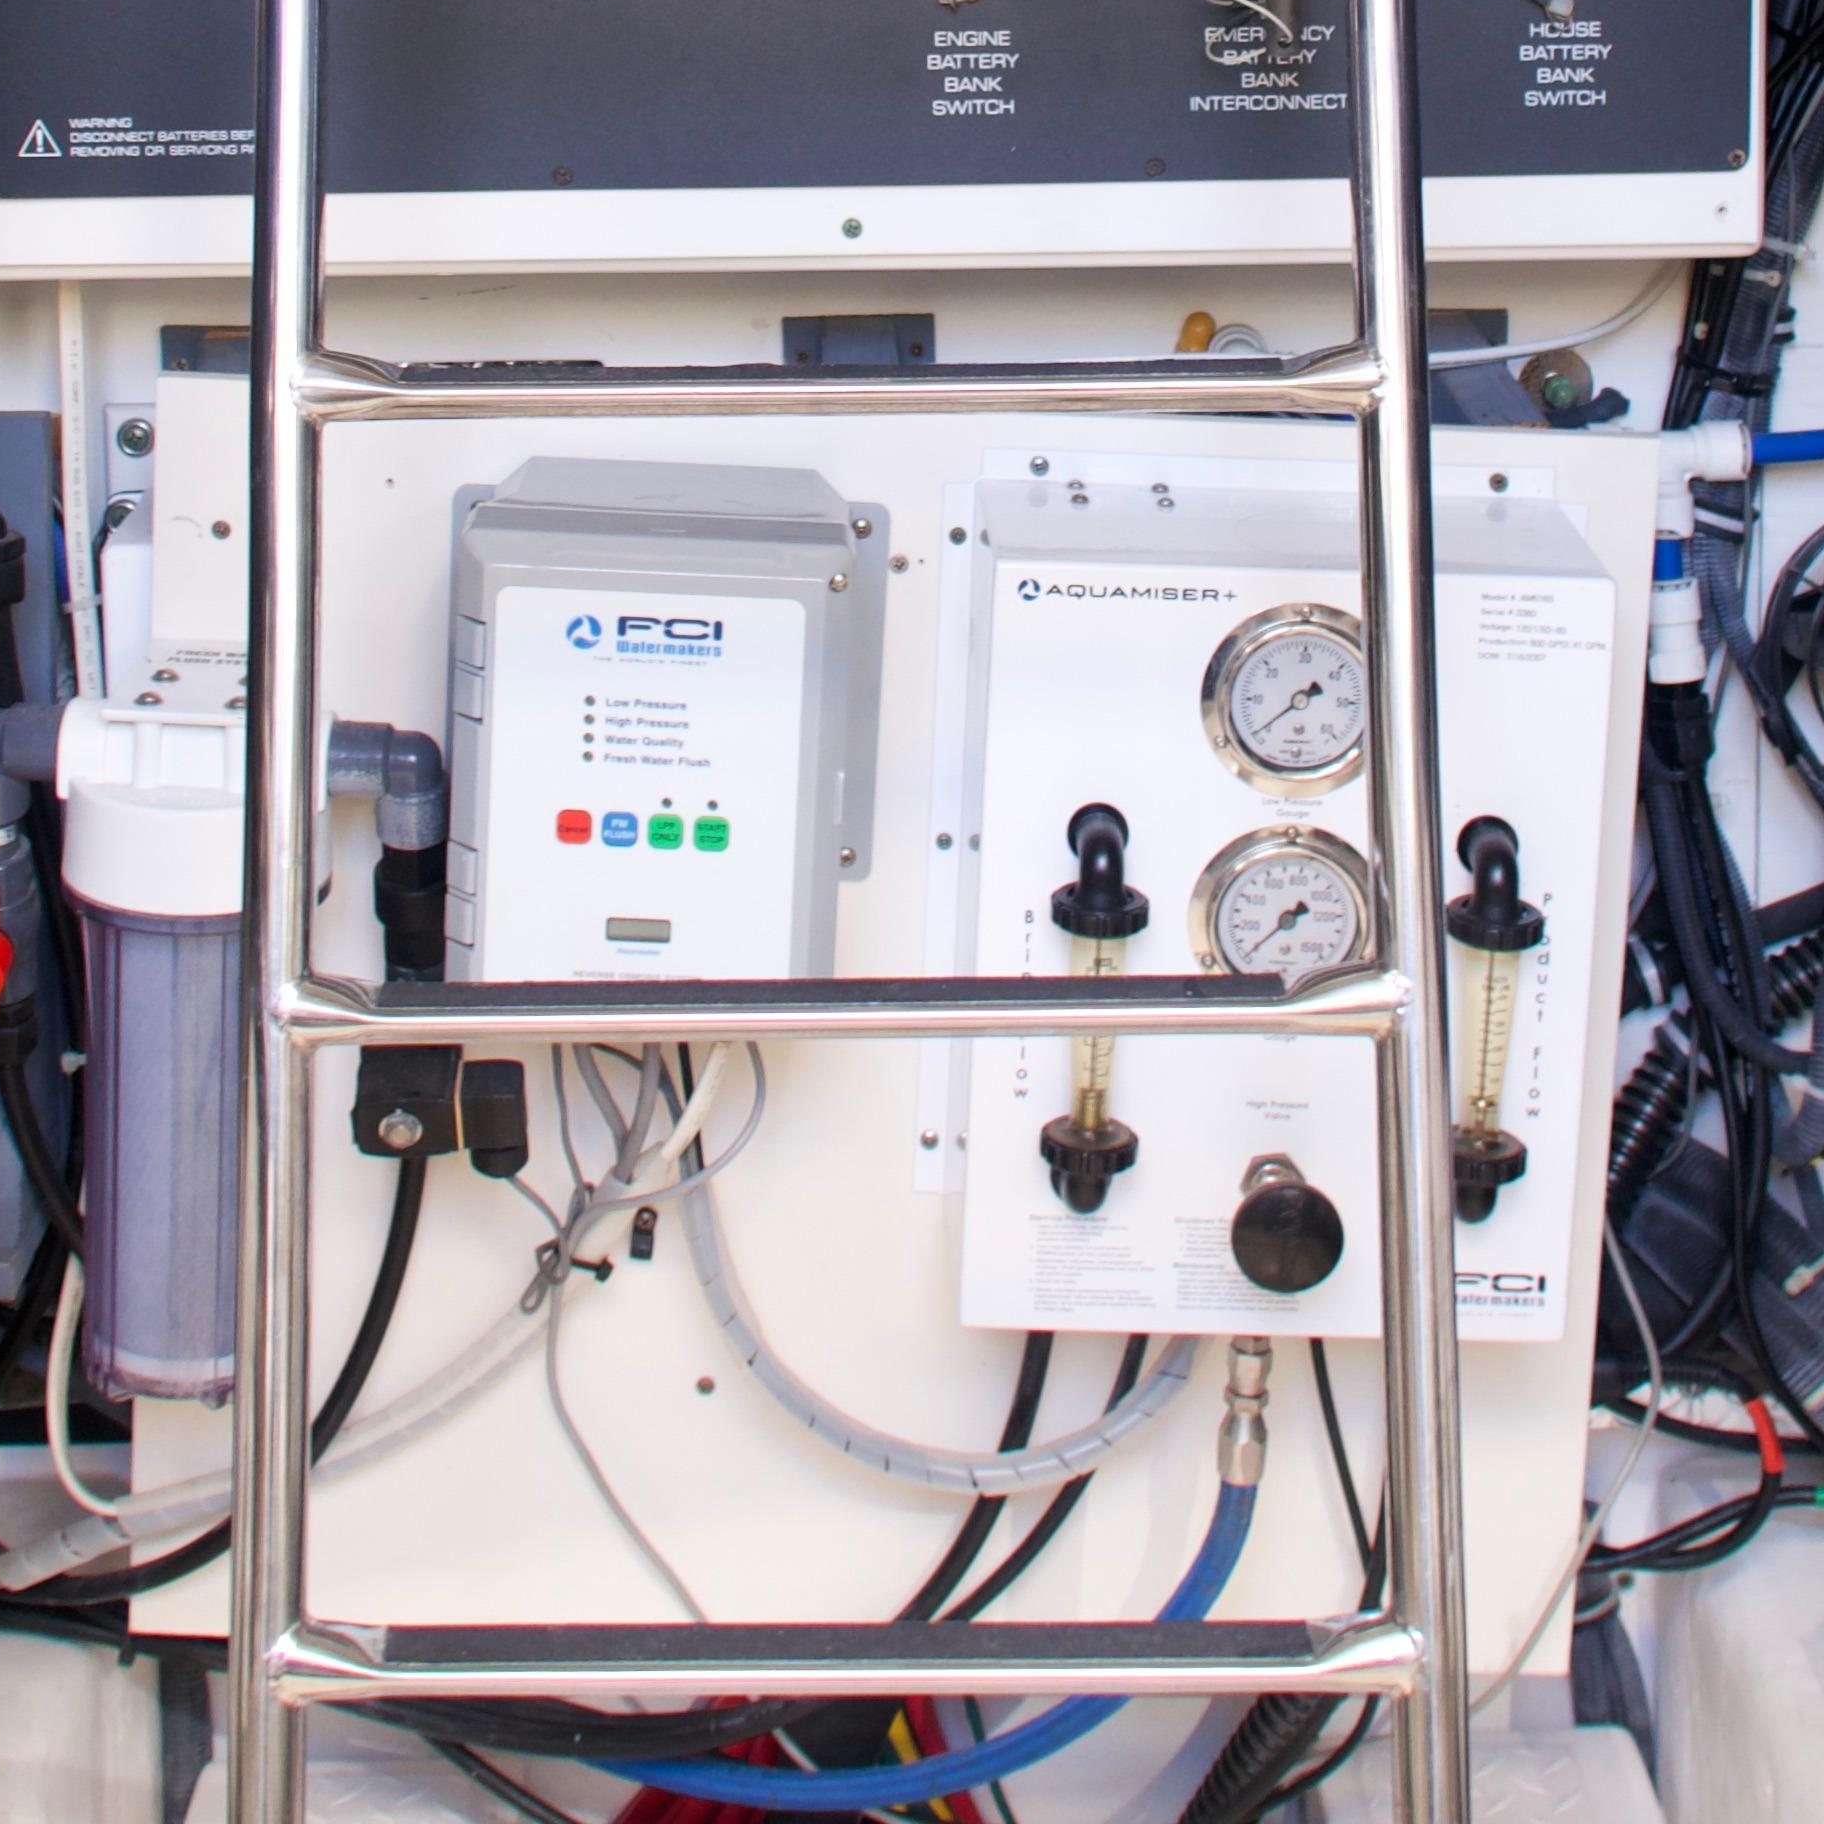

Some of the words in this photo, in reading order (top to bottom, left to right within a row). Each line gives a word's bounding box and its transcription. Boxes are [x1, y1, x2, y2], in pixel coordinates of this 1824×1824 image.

[1529, 21, 1602, 38] HOUSE
[933, 30, 1012, 47] ENGINE
[1519, 43, 1612, 61] BATTERY
[926, 53, 1020, 70] BATTERY
[1241, 72, 1300, 88] BANK
[1536, 66, 1595, 84] BANK
[944, 76, 1004, 93] BANK
[1190, 93, 1348, 111] INTERCONNECT
[1524, 89, 1606, 107] SWITCH
[931, 98, 1015, 116] SWITCH
[68, 117, 132, 129] WARNING
[69, 131, 155, 143] DISCONNECT
[157, 130, 228, 142] BATTERIES
[69, 145, 140, 157] REMOVING
[144, 144, 166, 157] OR
[169, 143, 238, 156] SERVICING
[1046, 582, 1239, 602] AQUAMISER+
[617, 616, 723, 641] FCI
[616, 640, 722, 658] Watermakers
[1298, 652, 1312, 664] 30
[1265, 667, 1279, 679] 20
[1328, 670, 1342, 682] 40
[605, 698, 630, 708] Low
[633, 698, 688, 711] Pressure
[1253, 693, 1264, 706] 10
[1336, 697, 1350, 709] 50
[604, 716, 633, 729] High
[636, 717, 690, 730] Pressure
[1320, 723, 1334, 736] 60
[604, 734, 639, 746] Water
[641, 736, 685, 749] Quality
[603, 752, 638, 765] Fresh
[640, 754, 674, 766] Water
[677, 756, 712, 769] Flush
[1262, 797, 1280, 807] Low
[1283, 796, 1324, 807] Pressure
[1275, 808, 1312, 819] Gauge
[611, 818, 630, 828] FW
[603, 829, 637, 840] FLUSH
[652, 832, 681, 842] ONLY
[698, 834, 725, 844] STOP
[1264, 877, 1284, 889] 600
[1289, 874, 1309, 886] 800
[1246, 895, 1266, 906] 400
[1310, 890, 1333, 902] 1000
[1313, 911, 1336, 923] 1200
[1240, 920, 1261, 931] 200
[1300, 942, 1324, 953] 1500
